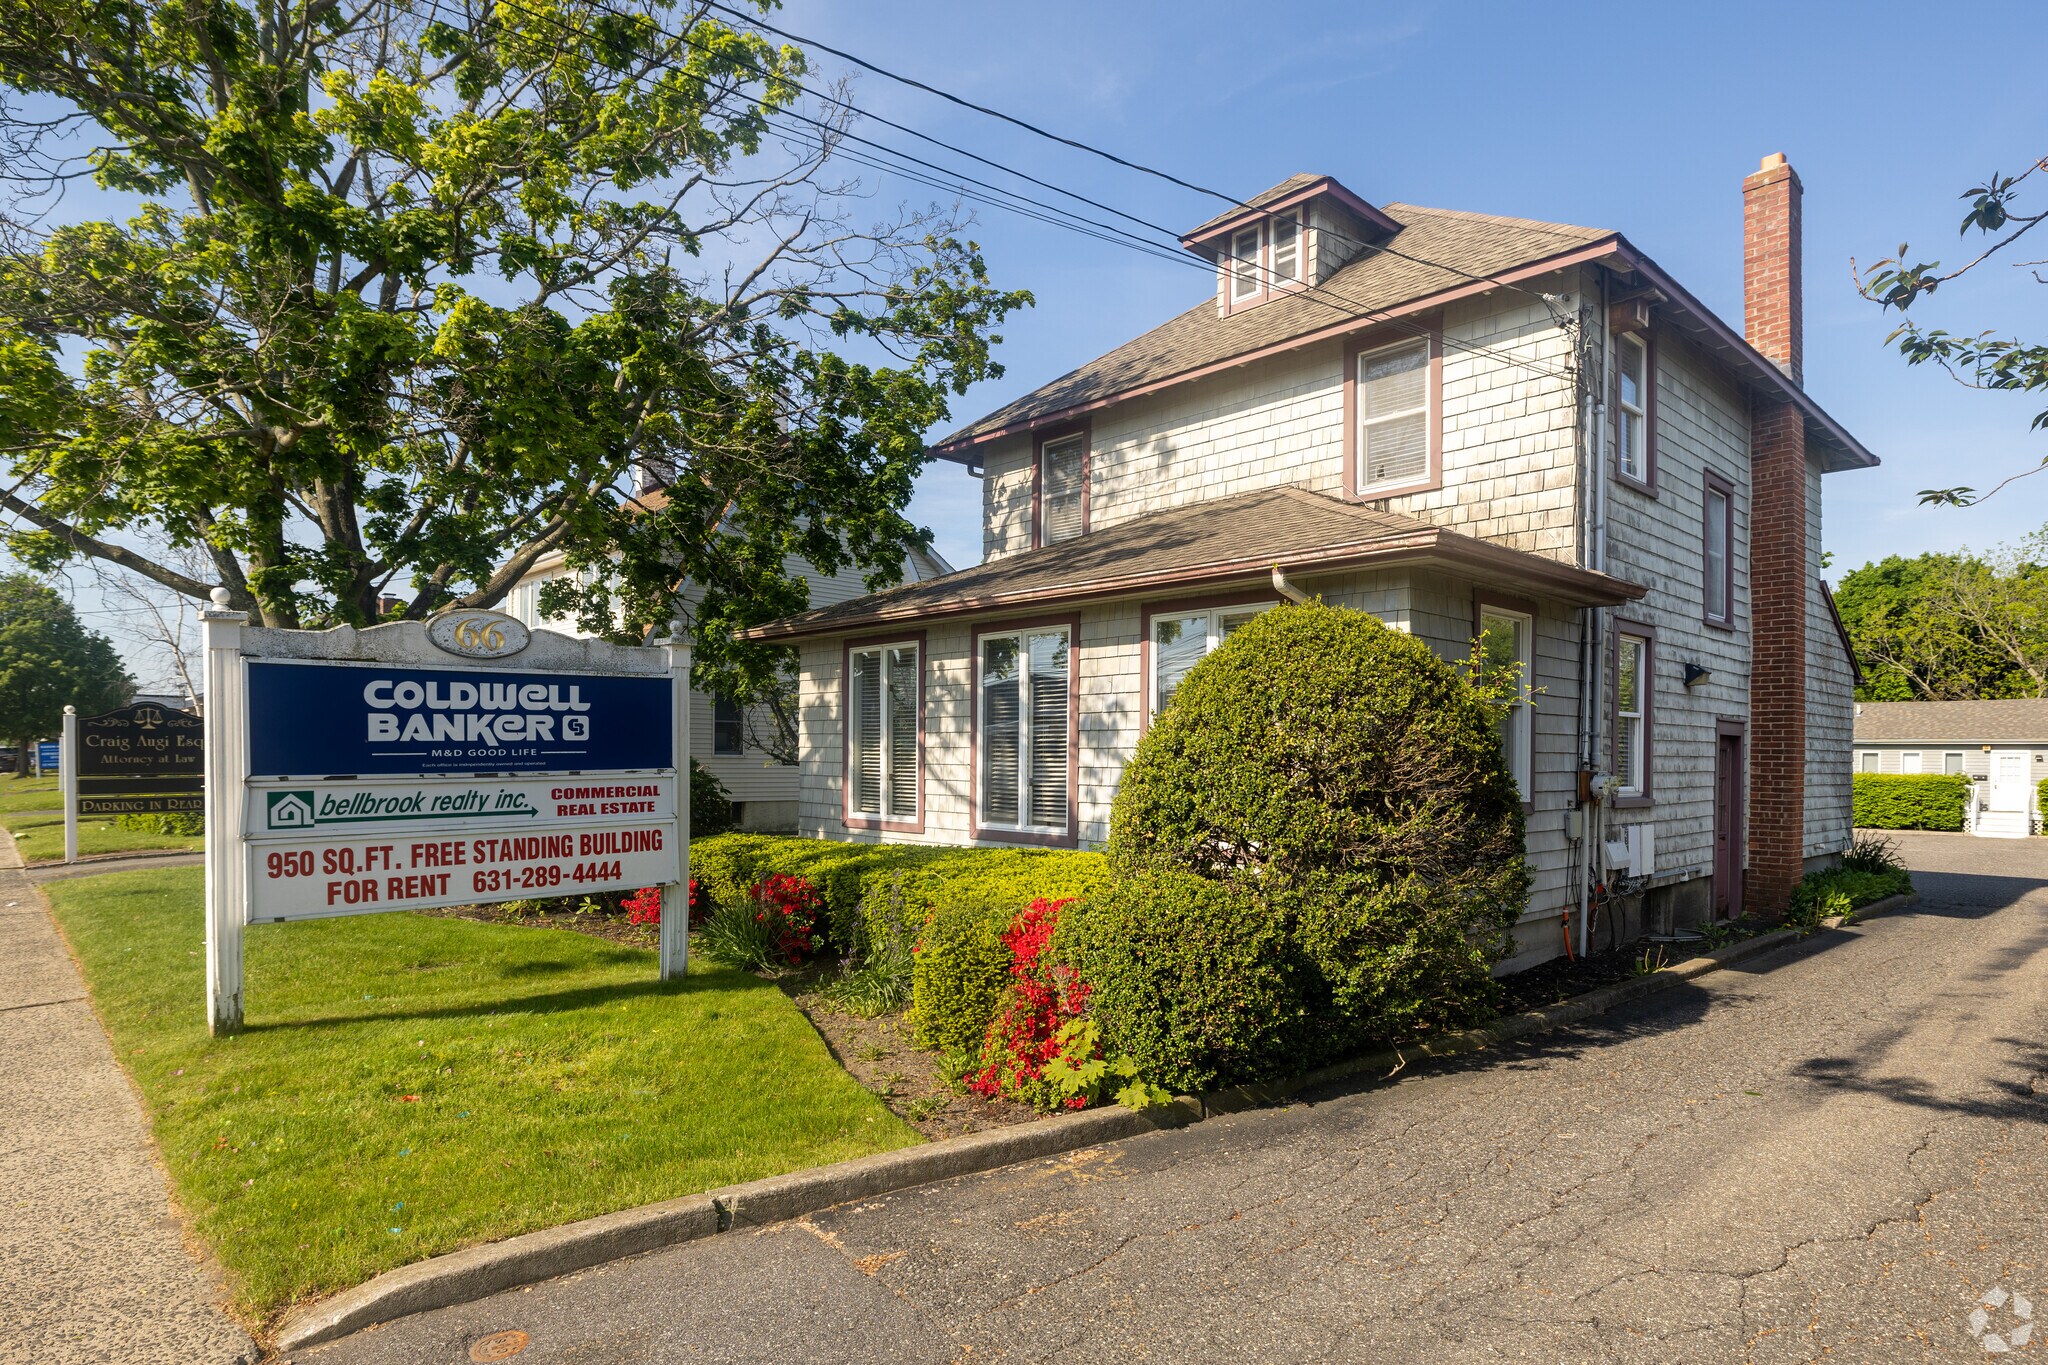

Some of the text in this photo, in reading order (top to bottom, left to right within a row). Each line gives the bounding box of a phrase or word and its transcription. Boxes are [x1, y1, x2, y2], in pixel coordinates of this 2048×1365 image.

[454, 618, 506, 650] 66
[85, 735, 131, 751] Craig
[136, 735, 169, 751] Augi
[100, 754, 196, 766] Attorney at Law
[431, 748, 538, 757] M&D GOOD LIFE
[551, 785, 660, 800] COMMERCIAL
[82, 799, 203, 812] PARKING IN REAR
[319, 789, 530, 816] bellbrook realty inc.
[557, 801, 656, 817] REAL ESTATE
[267, 829, 663, 879] 950 SQ.FT. FREE STANDING BUILDING
[327, 861, 622, 906] FOR RENT 631-289-4444
